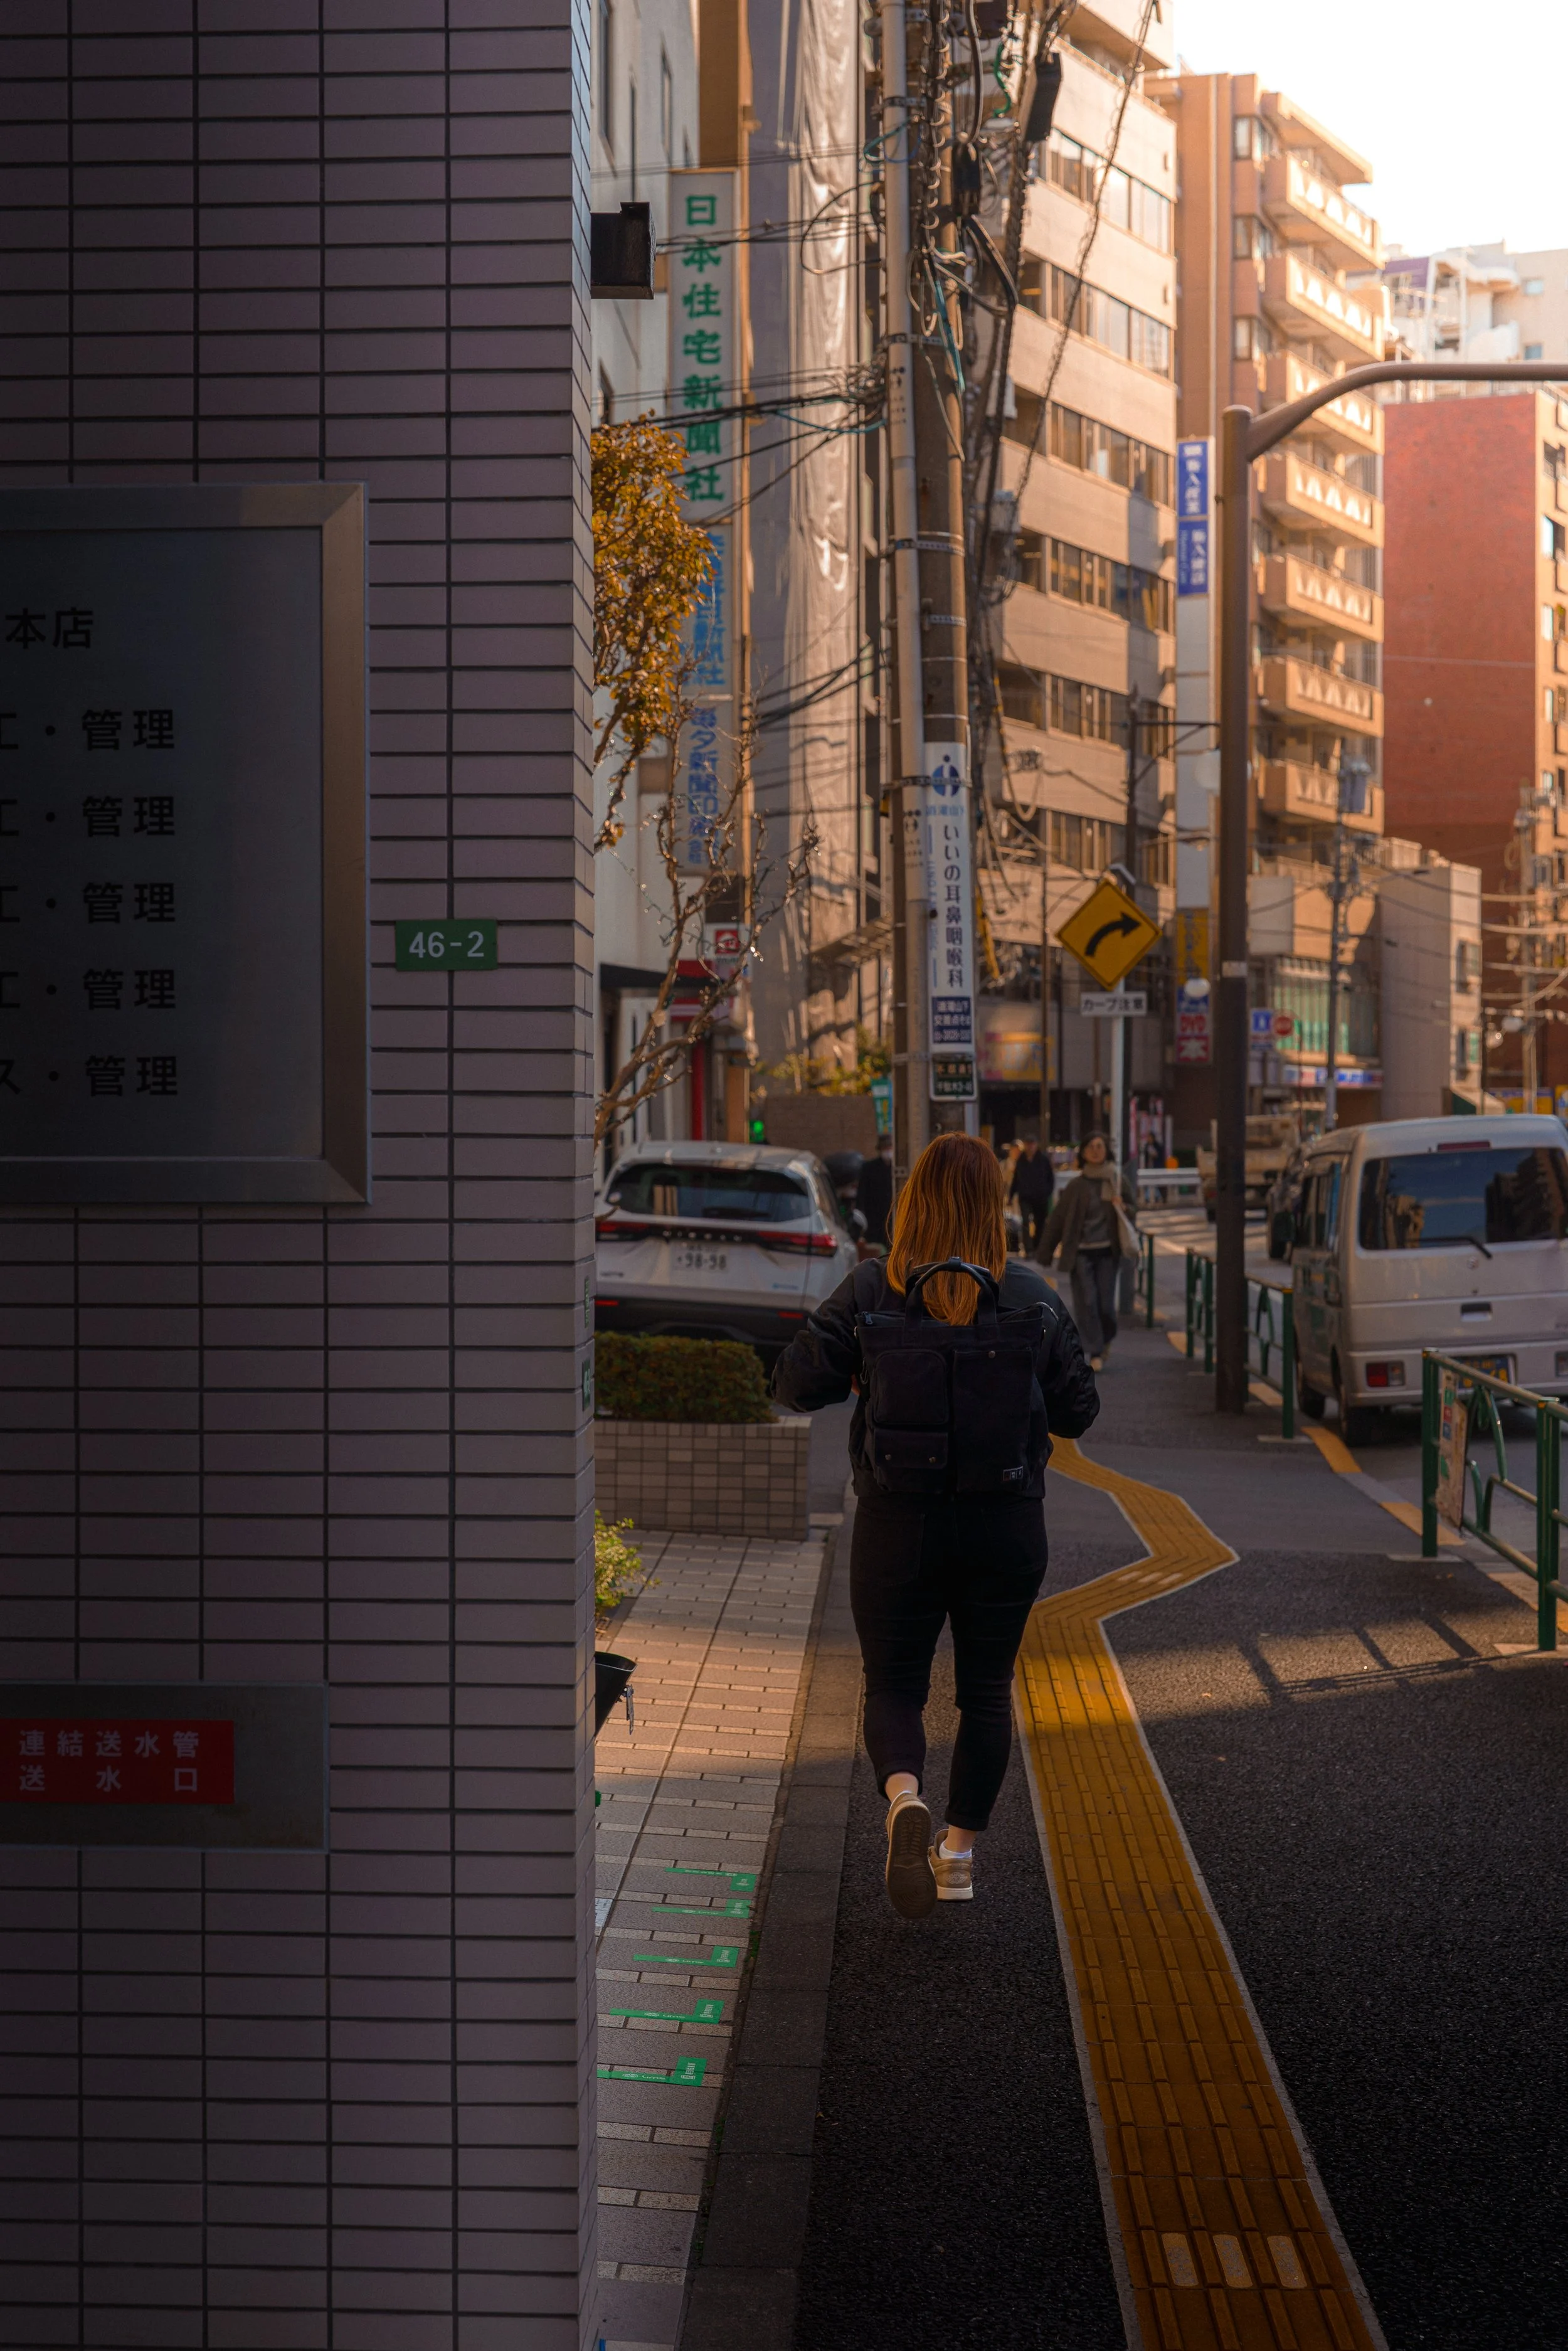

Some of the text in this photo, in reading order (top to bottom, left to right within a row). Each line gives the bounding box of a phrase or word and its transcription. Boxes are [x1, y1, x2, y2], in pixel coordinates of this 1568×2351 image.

[682, 194, 724, 501] 日本住宅新聞社
[5, 607, 93, 649] 本店
[944, 824, 963, 988] いいの耳鼻咽喉科
[408, 930, 485, 958] 46-2
[18, 1729, 199, 1758] 連結送水管
[18, 1765, 199, 1793] 送水口
